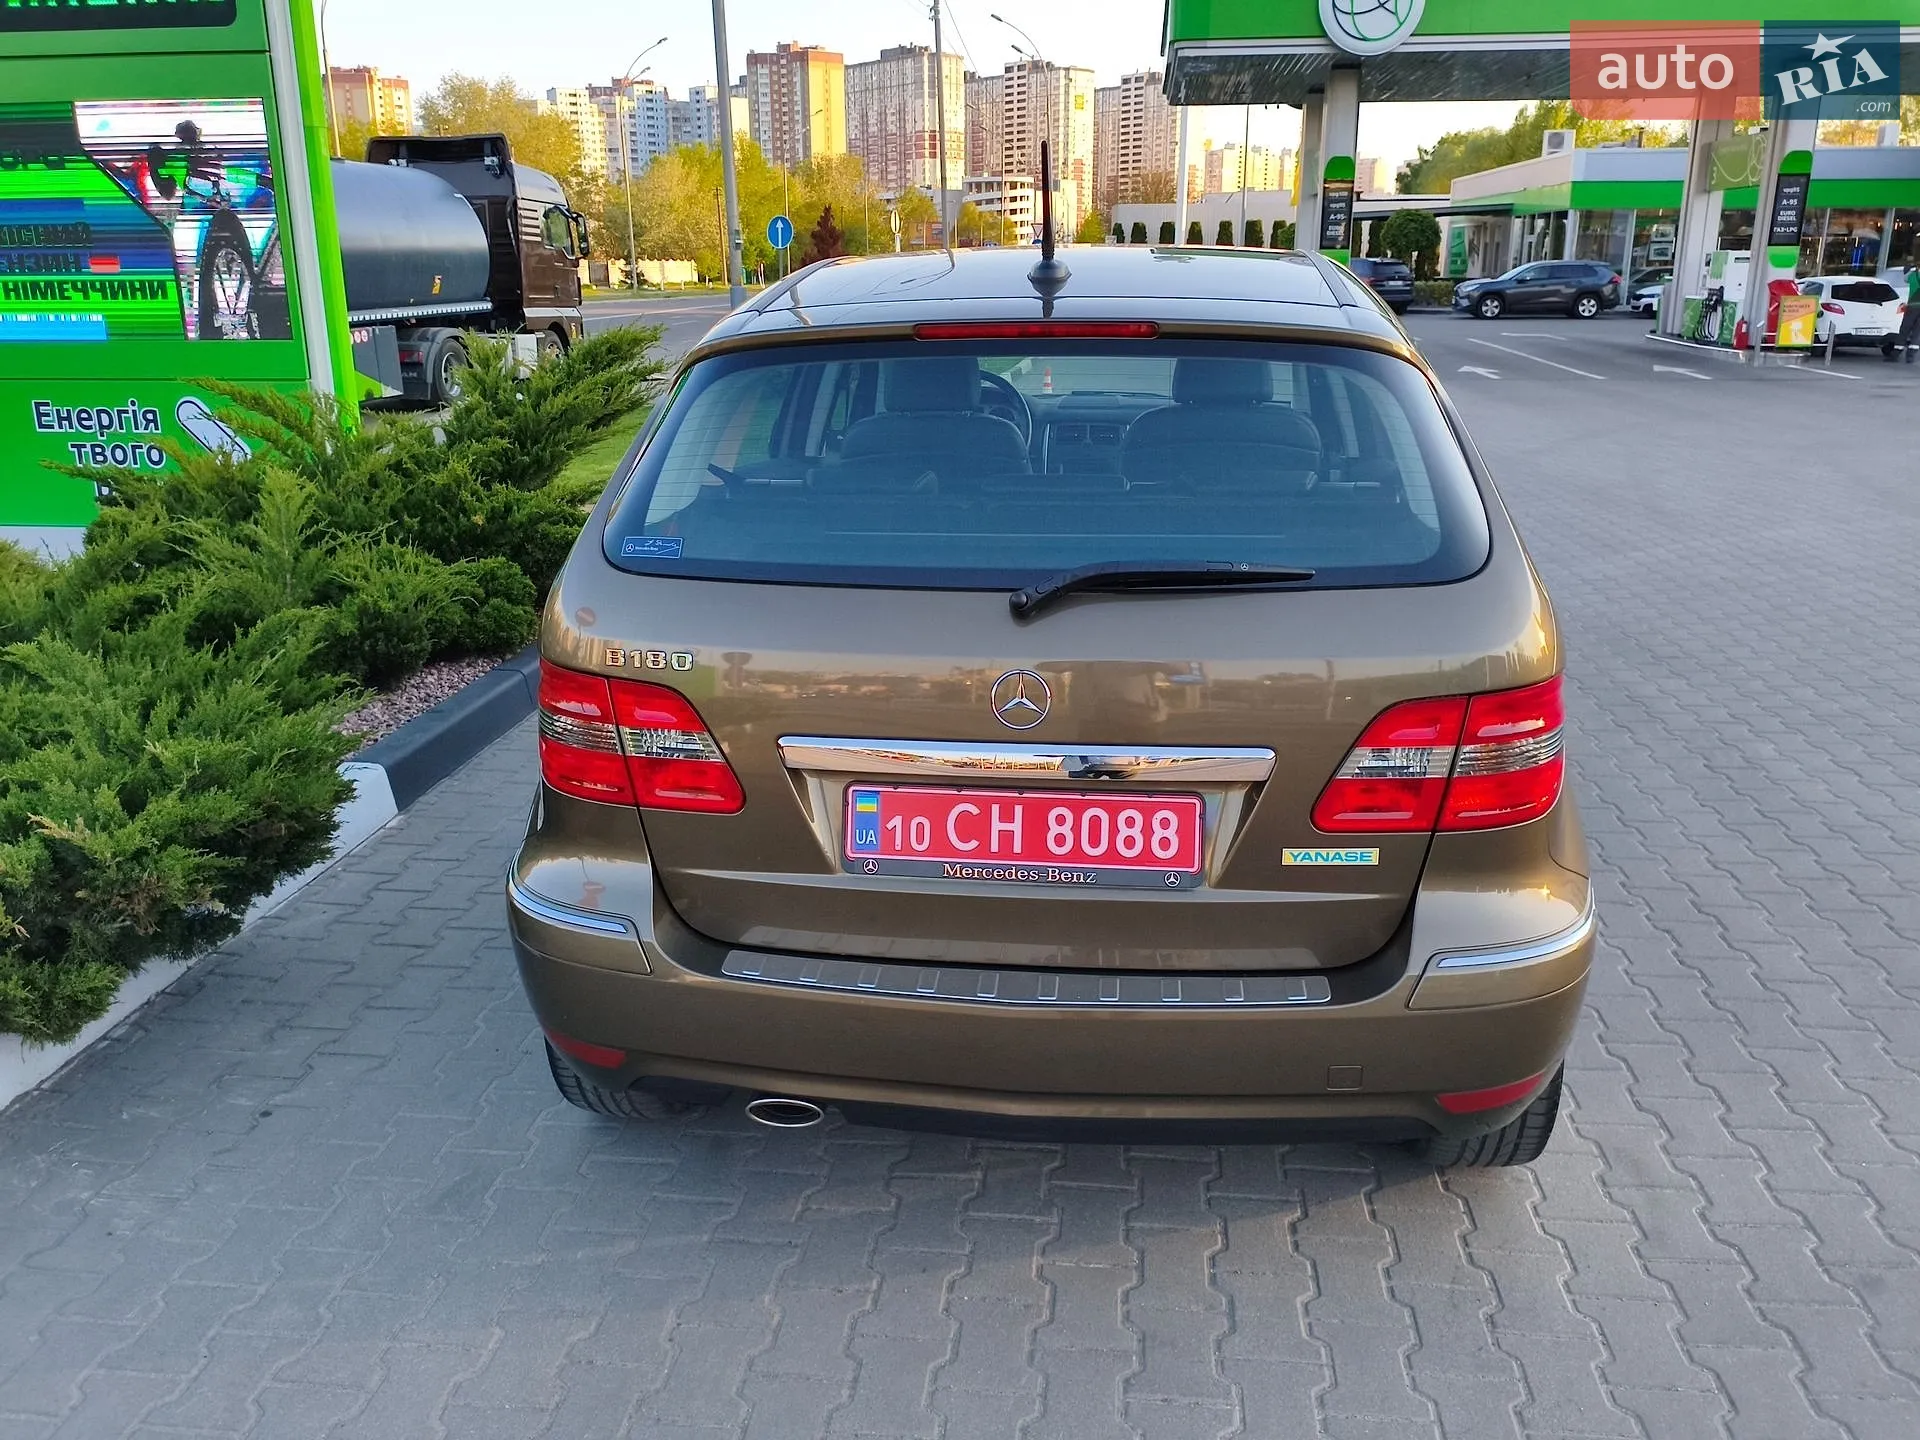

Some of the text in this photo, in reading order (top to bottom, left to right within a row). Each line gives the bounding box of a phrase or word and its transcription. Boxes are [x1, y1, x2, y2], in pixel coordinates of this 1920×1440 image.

[2, 280, 169, 301] НІМЕЧЧИНИ
[33, 399, 160, 438] Енергія
[69, 442, 165, 467] твого
[605, 648, 693, 671] B180
[855, 829, 878, 846] UA
[884, 802, 1180, 859] 10 CH 8088
[1288, 850, 1375, 864] YANASE
[942, 863, 1098, 885] Mercedes-Benz
